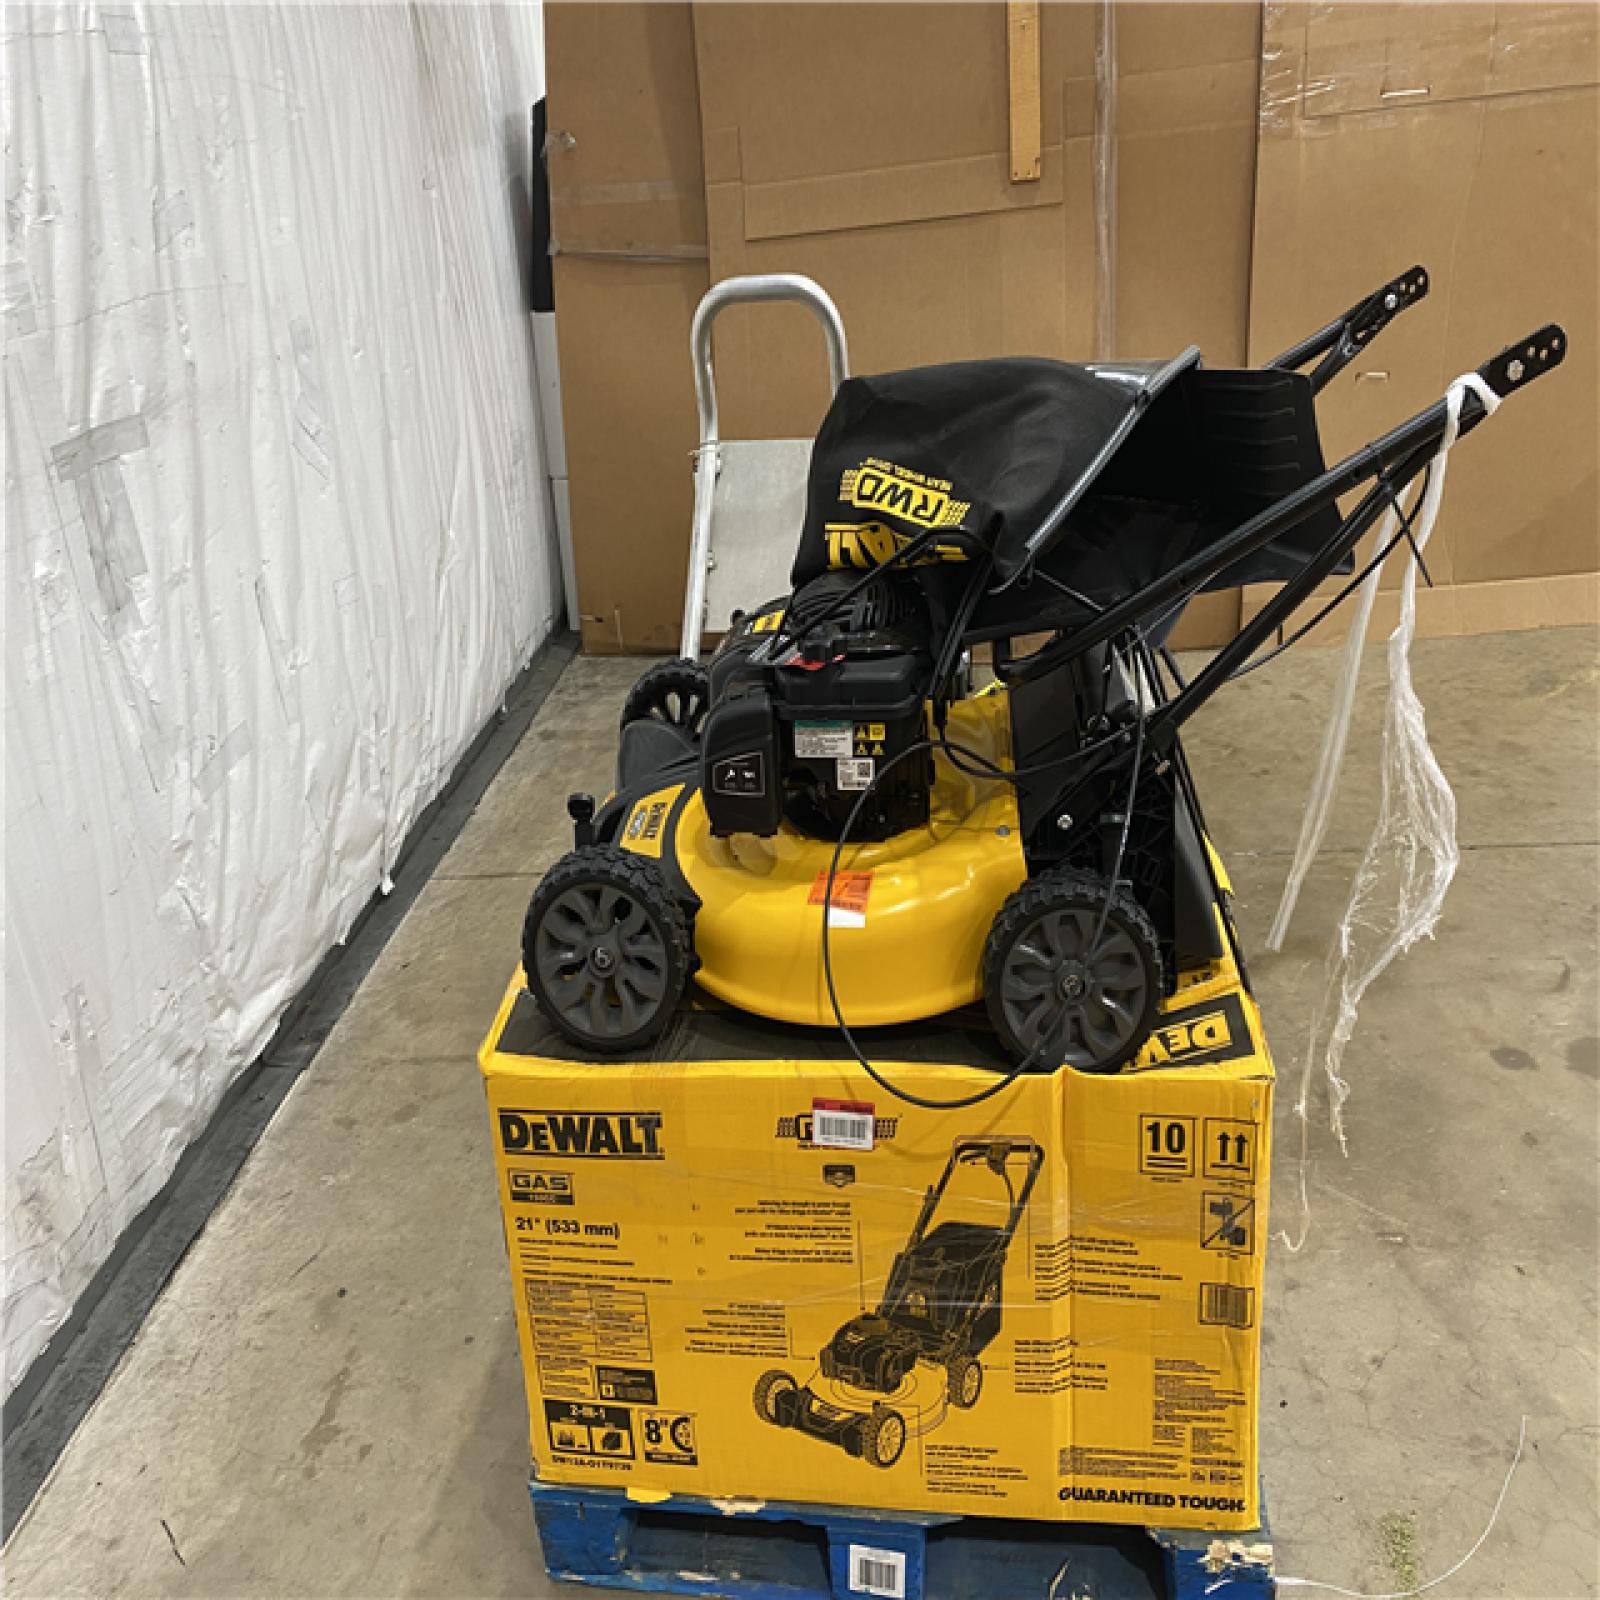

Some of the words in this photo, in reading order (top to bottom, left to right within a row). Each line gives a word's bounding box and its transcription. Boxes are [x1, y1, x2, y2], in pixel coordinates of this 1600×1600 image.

[857, 474, 943, 523] RWD
[1147, 1121, 1186, 1154] 10
[512, 1174, 568, 1191] GAS
[584, 1222, 621, 1241] mm)
[1058, 1486, 1176, 1508] GUARANTEED
